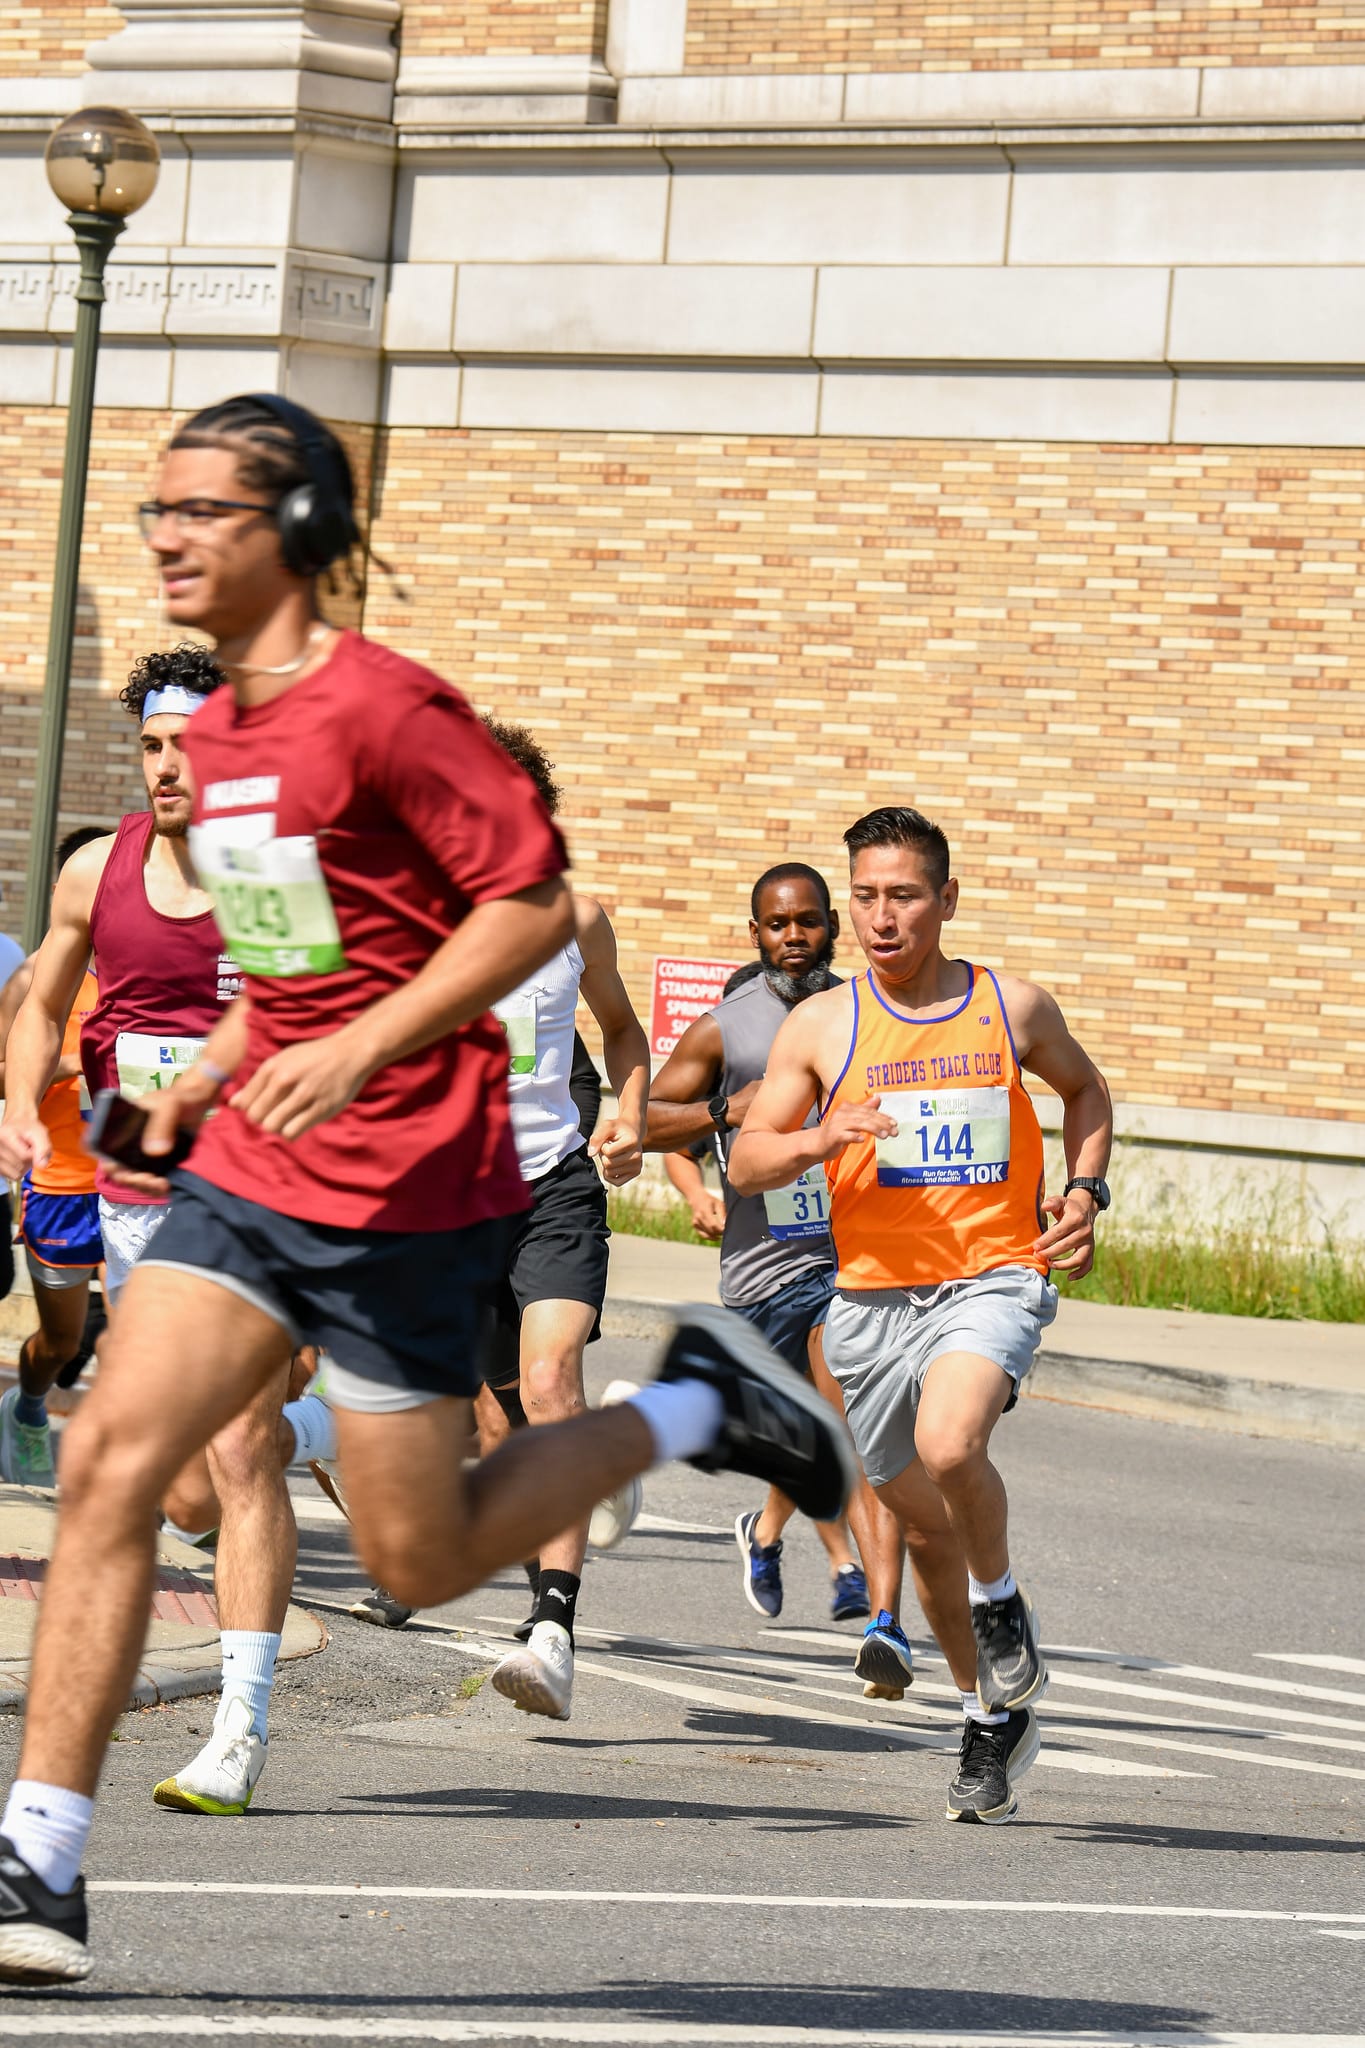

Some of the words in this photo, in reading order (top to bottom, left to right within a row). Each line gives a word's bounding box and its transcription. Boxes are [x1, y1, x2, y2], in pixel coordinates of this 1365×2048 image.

[660, 981, 724, 1000] STANDPIP
[867, 1060, 926, 1088] STRIDERS
[931, 1054, 970, 1080] TRACK
[975, 1053, 1002, 1075] CLUB
[915, 1123, 974, 1162] 144
[937, 1169, 947, 1177] for
[964, 1164, 1003, 1184] 10K
[793, 1190, 829, 1221] 31
